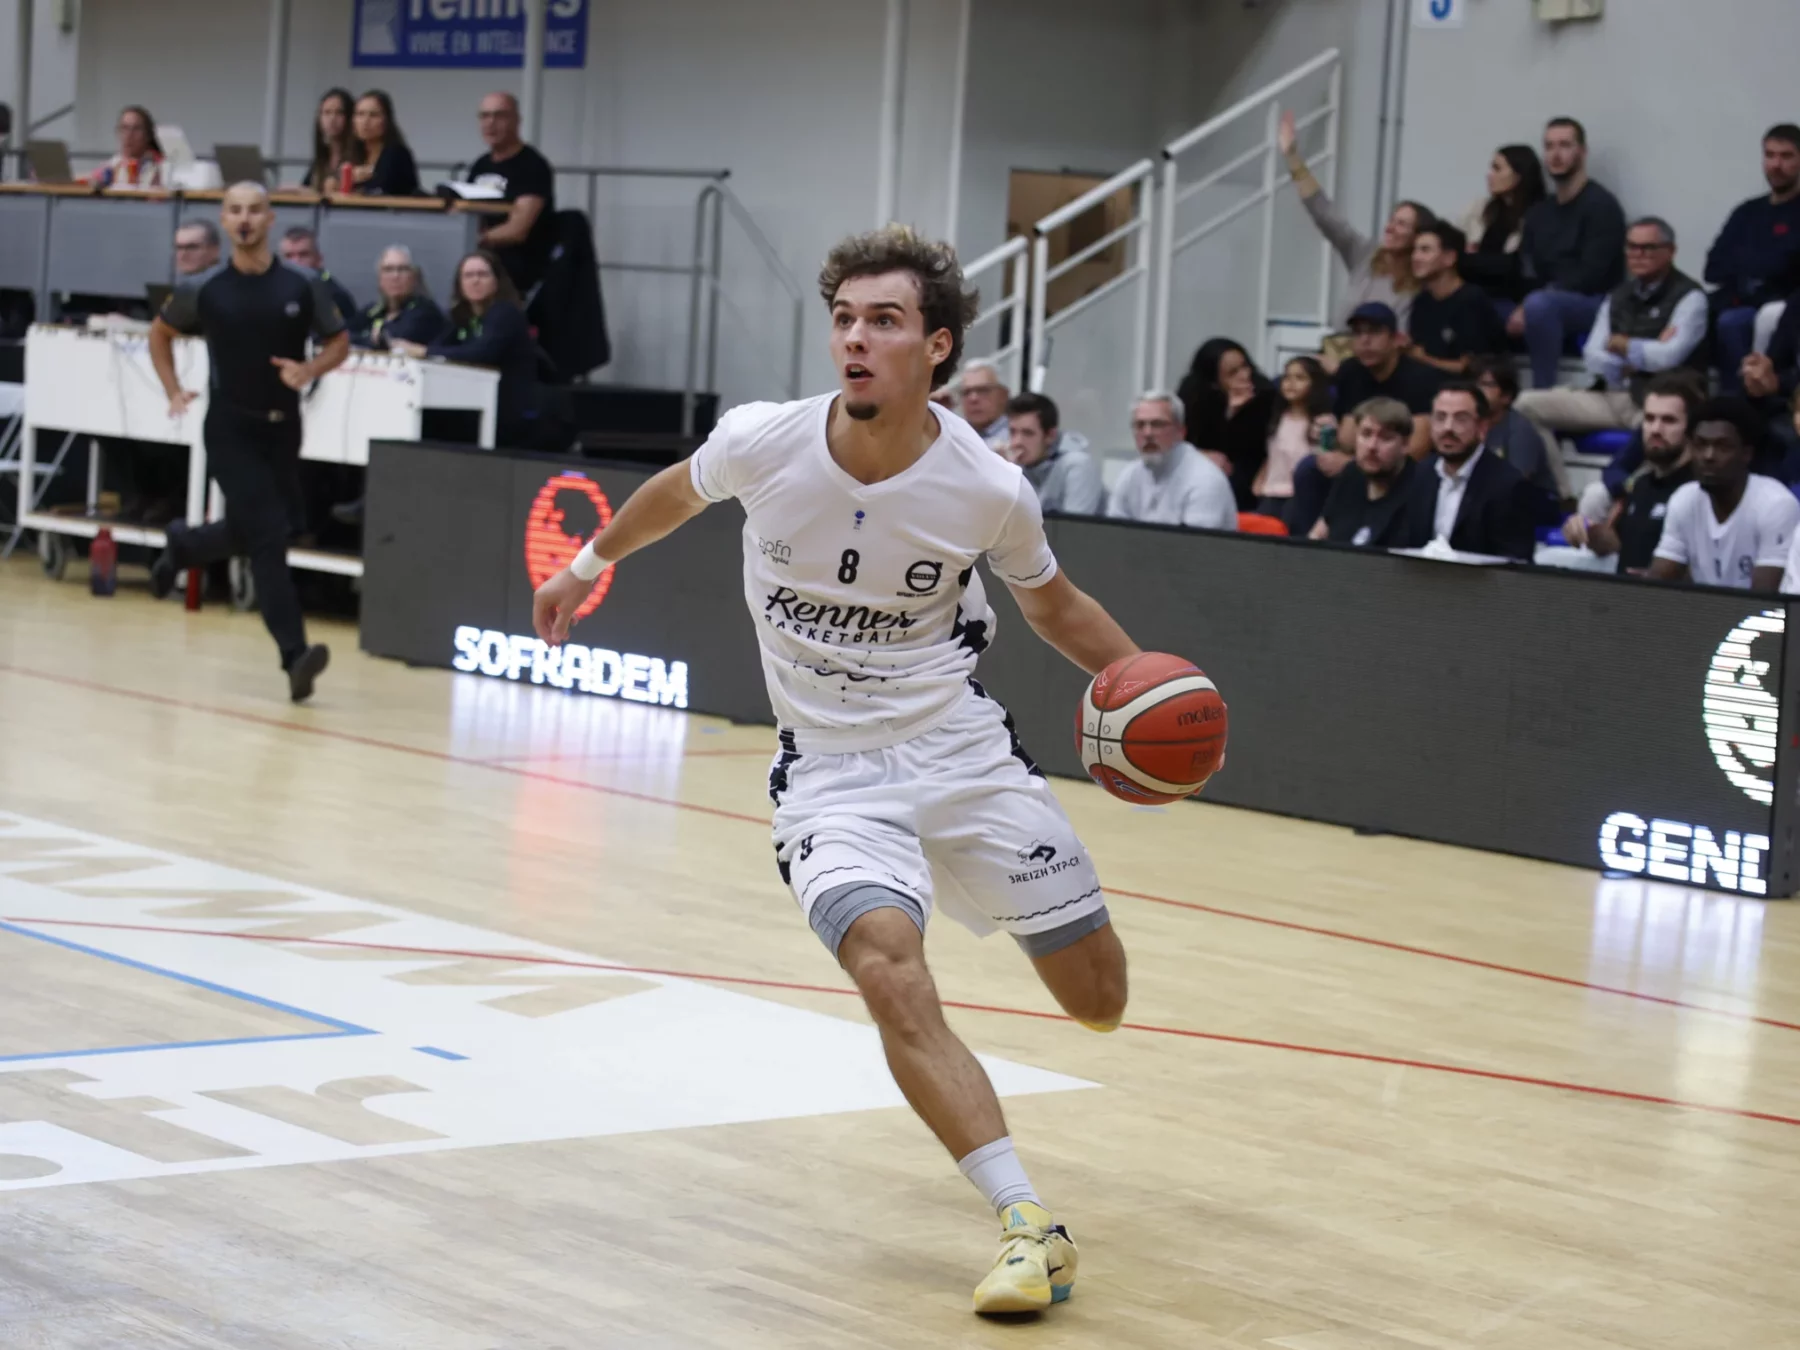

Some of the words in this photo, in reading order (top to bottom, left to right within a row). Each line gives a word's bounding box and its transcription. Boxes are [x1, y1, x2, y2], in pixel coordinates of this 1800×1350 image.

[408, 0, 582, 20] renns
[837, 548, 860, 584] 8
[764, 614, 908, 644] BASKETBAL
[452, 625, 688, 708] SOFRADEM
